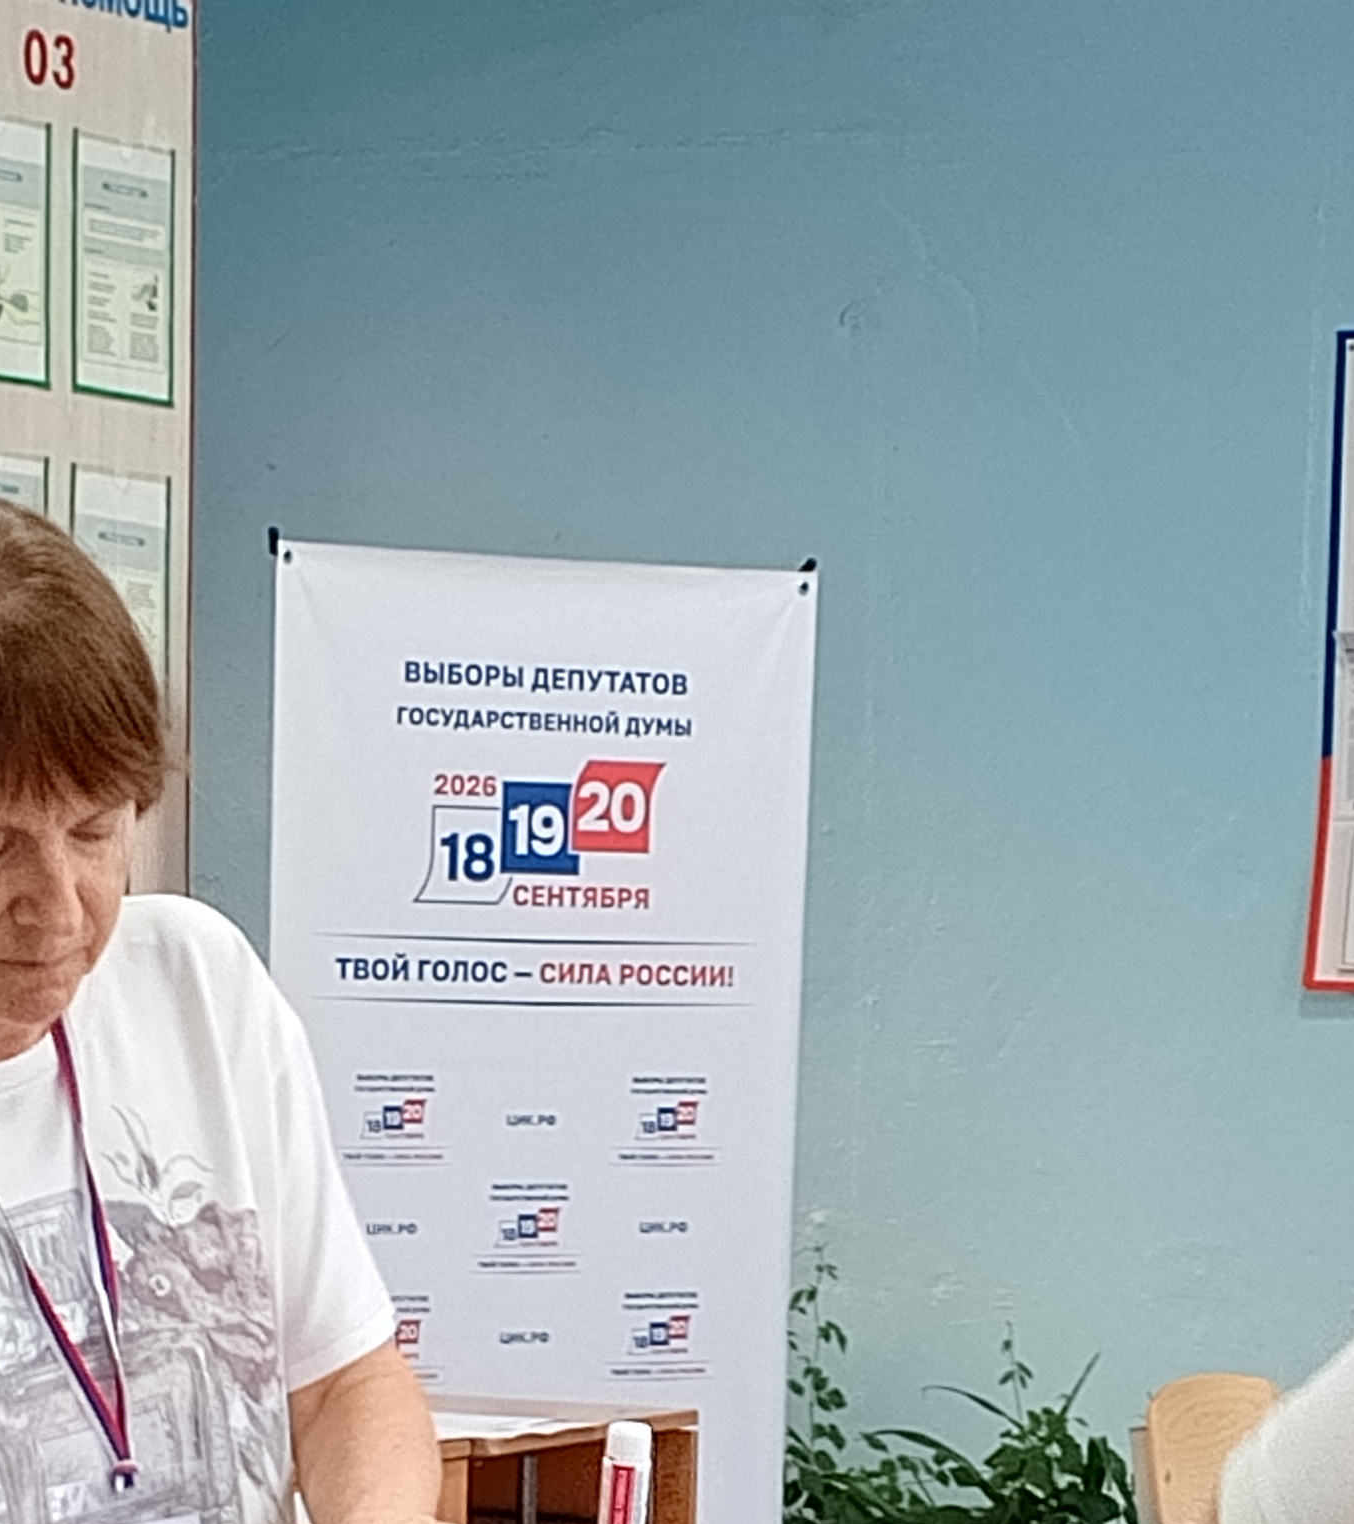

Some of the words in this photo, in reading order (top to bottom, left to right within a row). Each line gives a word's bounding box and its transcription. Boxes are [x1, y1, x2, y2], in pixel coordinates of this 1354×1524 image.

[23, 28, 75, 90] 03
[404, 662, 524, 688] ВЫБОРЫ
[531, 668, 688, 696] ДЕПУТАТОВ
[397, 705, 620, 735] ГОСУДАРСТВЕННОЙ
[625, 716, 692, 738] ДУМЫ
[434, 774, 497, 797] 2026
[440, 831, 495, 882] 18
[509, 803, 566, 857] 19
[577, 780, 646, 834] 20
[512, 884, 650, 909] СЕНТЯБРЯ
[335, 953, 409, 982] ТВОЙ
[417, 959, 507, 984] ГОЛОС
[539, 962, 612, 985] СИЛА
[619, 964, 735, 988] РОССИИ!
